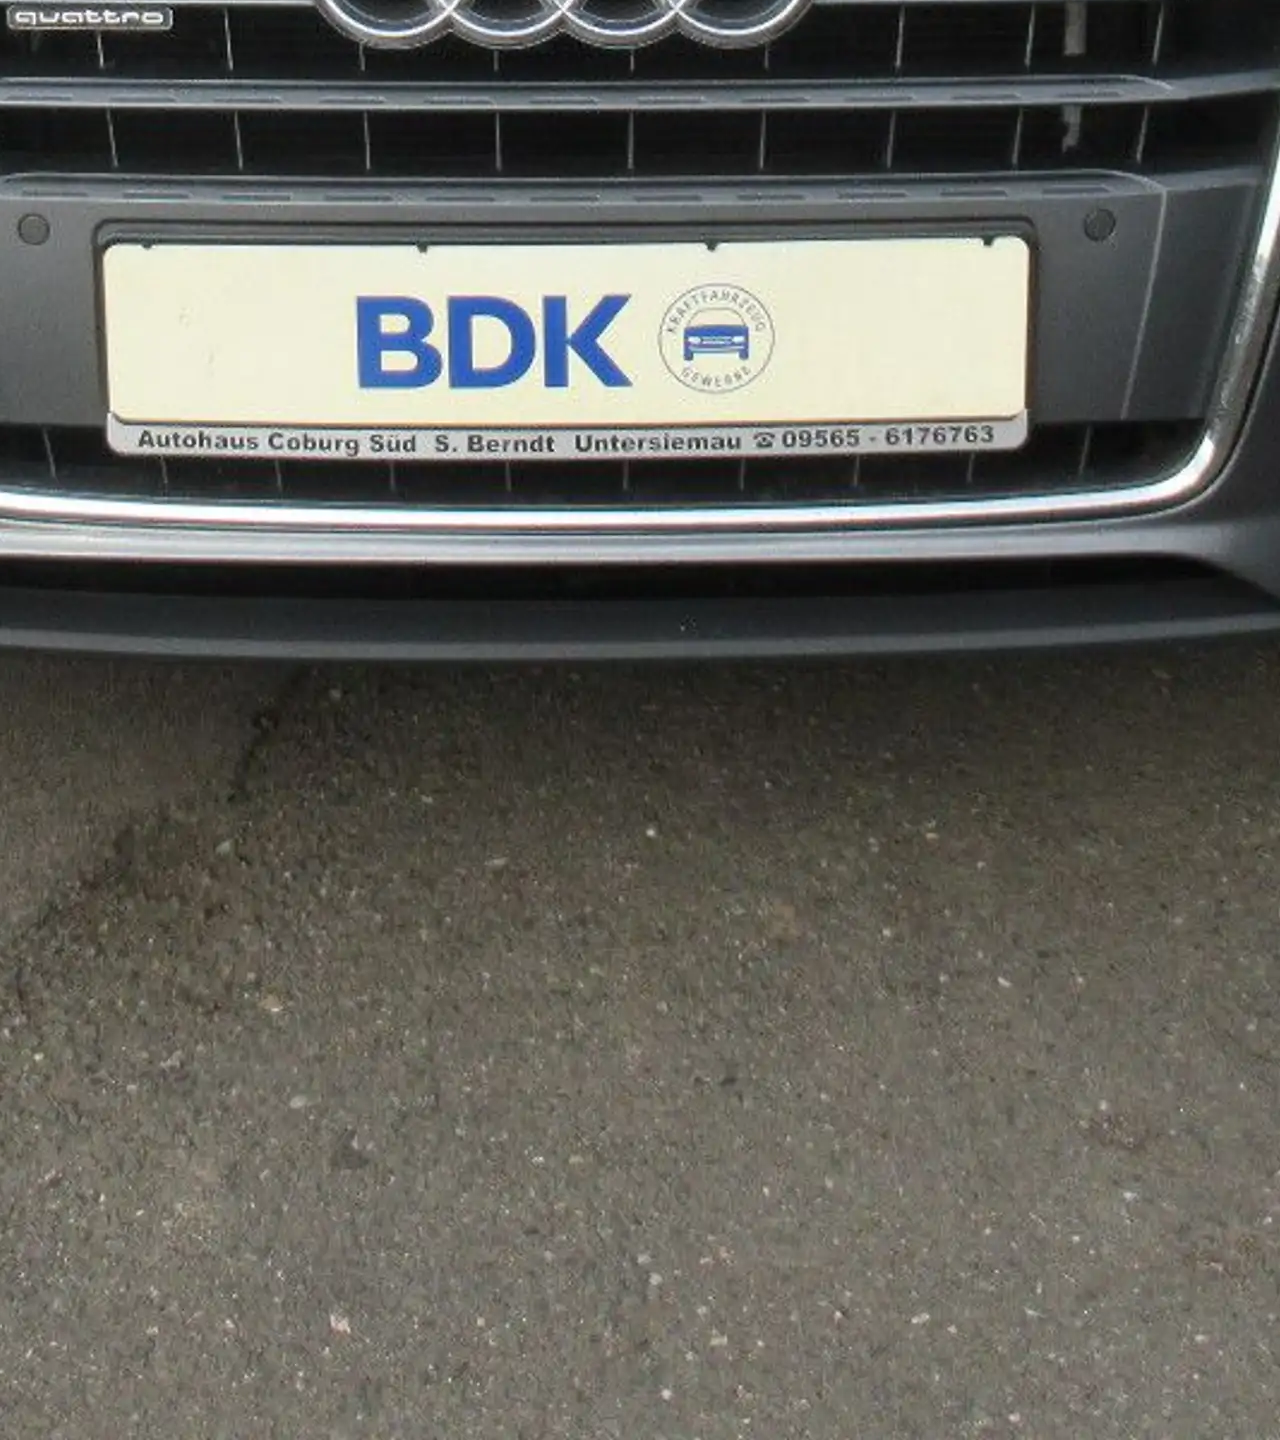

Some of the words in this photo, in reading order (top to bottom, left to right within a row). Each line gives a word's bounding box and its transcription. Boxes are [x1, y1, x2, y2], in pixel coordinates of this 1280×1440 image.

[14, 9, 164, 26] quattro
[356, 294, 632, 389] BDK
[138, 430, 259, 450] Autohaus
[268, 432, 360, 457] Coburg
[370, 434, 417, 453] Süd
[434, 434, 458, 453] S.
[467, 434, 556, 453] Berndt
[575, 433, 741, 453] Untersiemau
[781, 429, 861, 449] 09565
[884, 424, 995, 446] 6176763
